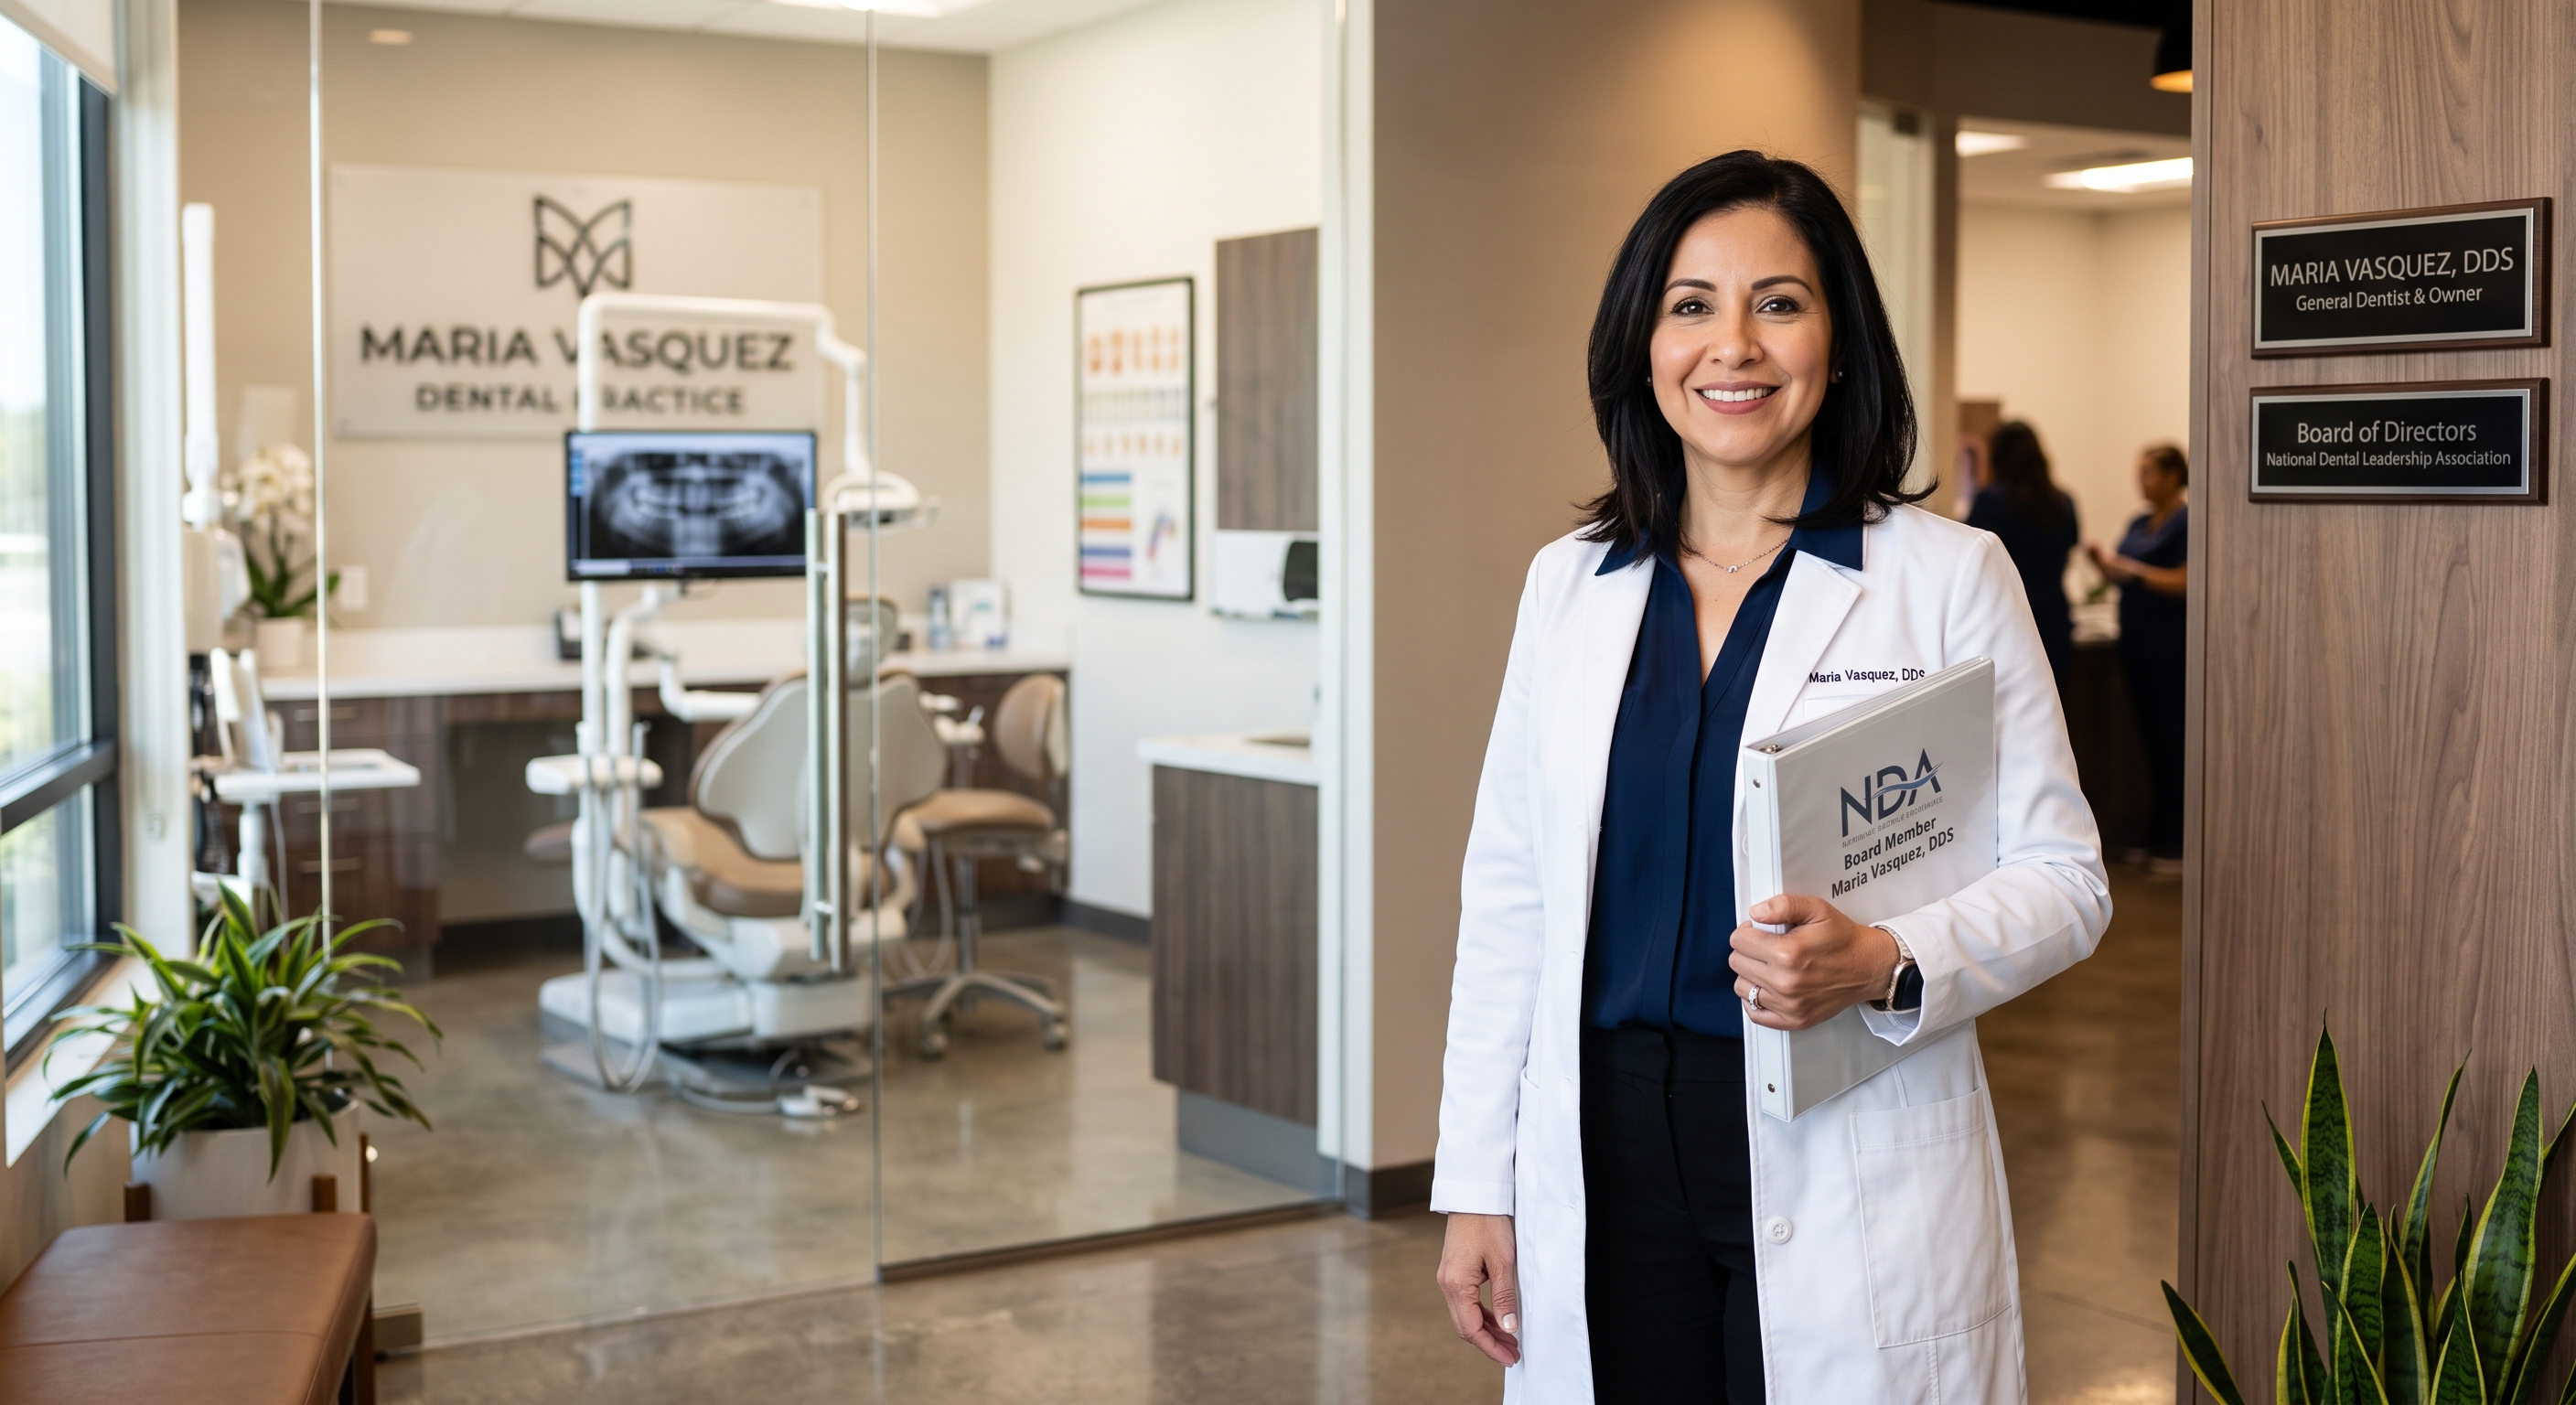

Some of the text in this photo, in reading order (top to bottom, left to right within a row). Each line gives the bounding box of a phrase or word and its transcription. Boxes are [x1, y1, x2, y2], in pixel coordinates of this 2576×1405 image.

[2270, 247, 2514, 287] MARIA VASQUEZ, DDS
[2296, 286, 2483, 311] General Dentist & Owner
[360, 326, 538, 365] MARIA
[415, 383, 746, 415] DENTAL RACTICE
[2297, 420, 2477, 444] Board of Directors
[2267, 449, 2511, 469] National Dental Leadership Association
[1809, 670, 1841, 683] Maria
[1844, 669, 1899, 683] Vasquez,
[1840, 747, 1942, 839] NDA
[1843, 839, 1883, 871] Board
[1884, 817, 1937, 852] Member
[1830, 827, 1955, 899] Maria Vasquez, DDS
